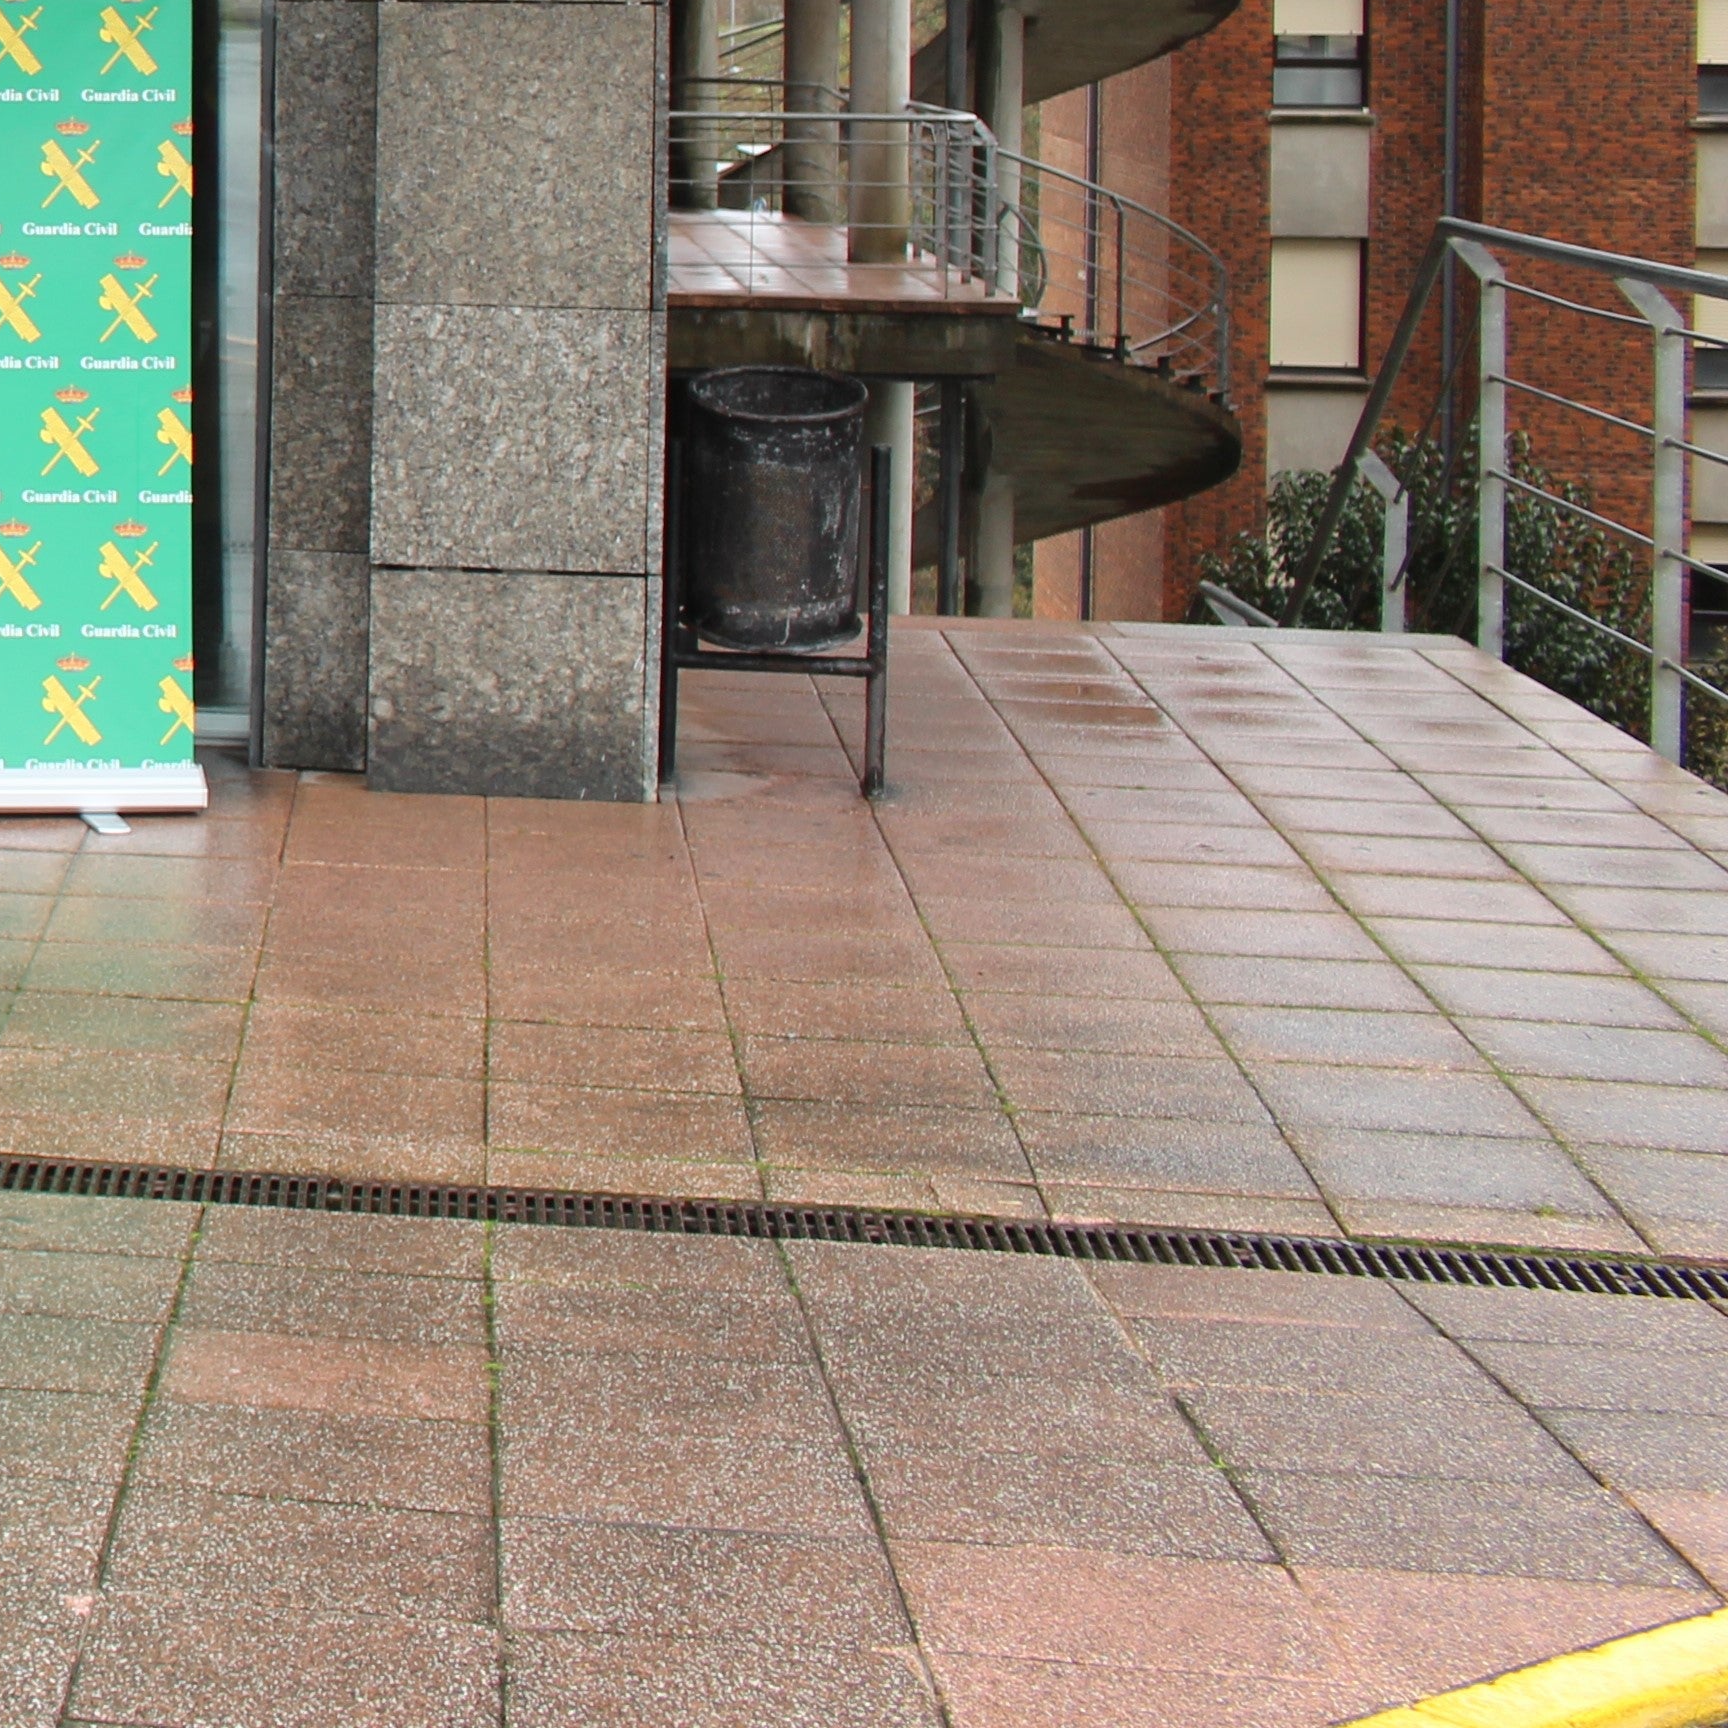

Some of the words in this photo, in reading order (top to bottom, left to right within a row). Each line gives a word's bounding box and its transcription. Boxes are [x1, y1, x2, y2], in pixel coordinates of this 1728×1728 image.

[26, 88, 60, 102] Civil
[81, 88, 140, 102] Guardia
[143, 88, 177, 102] Civil
[21, 222, 80, 236] Guardia
[85, 222, 119, 236] Civil
[26, 355, 60, 369] Civil
[80, 356, 139, 370] Guardia
[143, 356, 177, 370] Civil
[21, 489, 80, 504] Guardia
[85, 489, 119, 504] Civil
[27, 623, 61, 638] Civil
[80, 623, 139, 639] Guardia
[144, 623, 178, 639] Civil
[24, 757, 83, 770] Guardia
[87, 757, 121, 770] Civil
